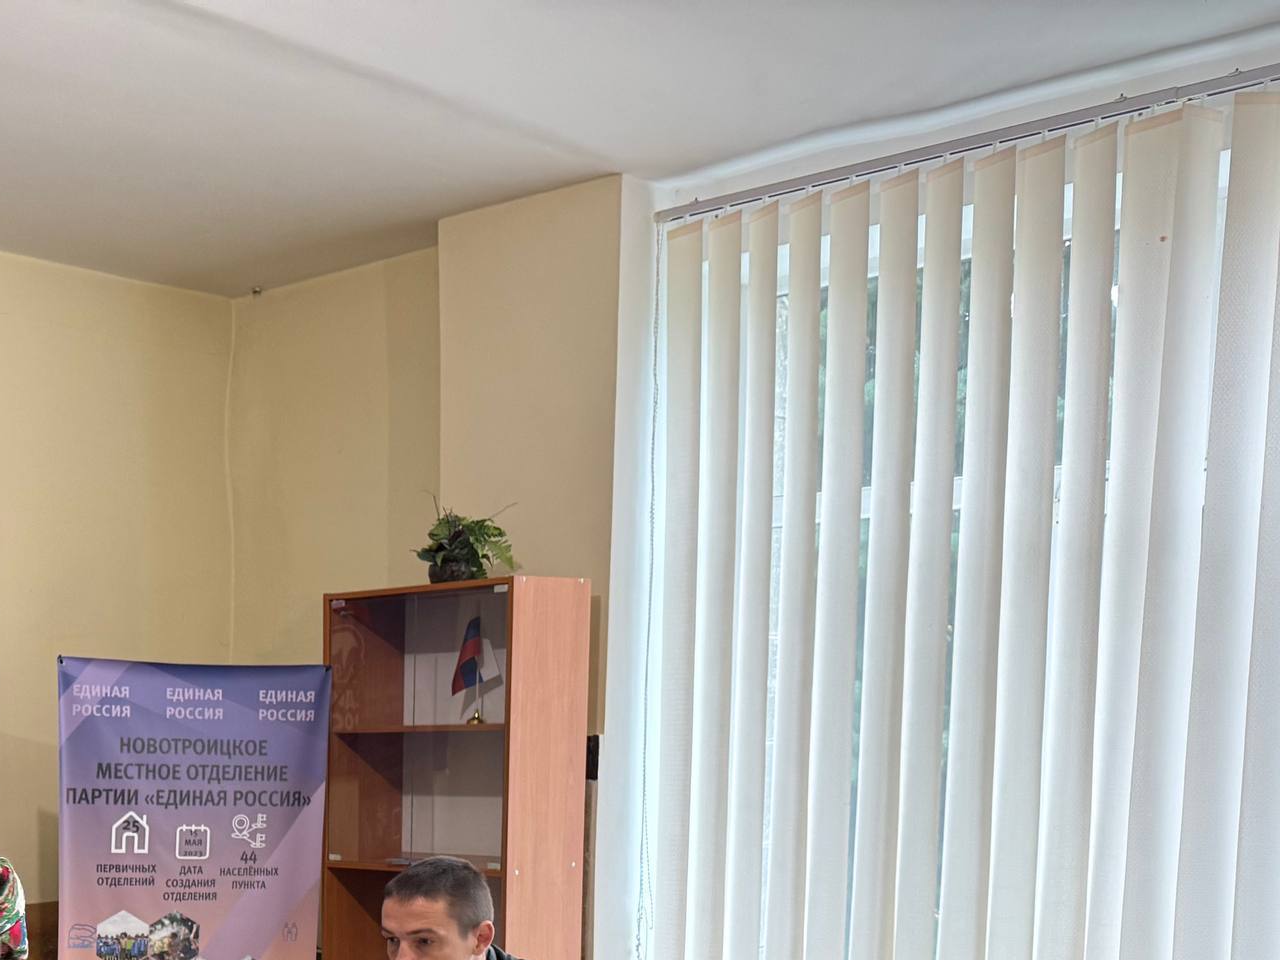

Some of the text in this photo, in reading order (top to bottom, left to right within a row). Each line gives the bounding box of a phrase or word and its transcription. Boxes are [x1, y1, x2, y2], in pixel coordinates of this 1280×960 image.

[73, 684, 130, 700] ЕДИНАЯ
[166, 687, 223, 702] ЕДИНАЯ
[258, 690, 316, 704] ЕДИНАЯ
[72, 703, 131, 718] РОССИЯ
[166, 706, 223, 720] РОССИЯ
[258, 708, 315, 722] РОССИЯ
[119, 736, 268, 759] НОВОТРОИЦКОЕ
[95, 762, 289, 784] МЕСТНОЕ ОТДЕЛЕНИЕ
[66, 788, 312, 810] ПАРТИИ «ЕДИНАЯ РОССИЯ»
[122, 820, 140, 833] 25
[184, 838, 203, 847] МАЯ
[240, 851, 257, 864] 44
[96, 863, 157, 875] ПЕРВИЧНЫХ
[179, 865, 204, 876] ДАТА
[220, 865, 279, 877] НАСЕЛЁННЫХ
[96, 875, 155, 888] ОТДЕЛЕНИЙ
[165, 877, 216, 889] СОЗДАНИЯ
[231, 880, 267, 890] ПУНКТА
[162, 890, 218, 902] ОТДЕЛЕНИЯ
